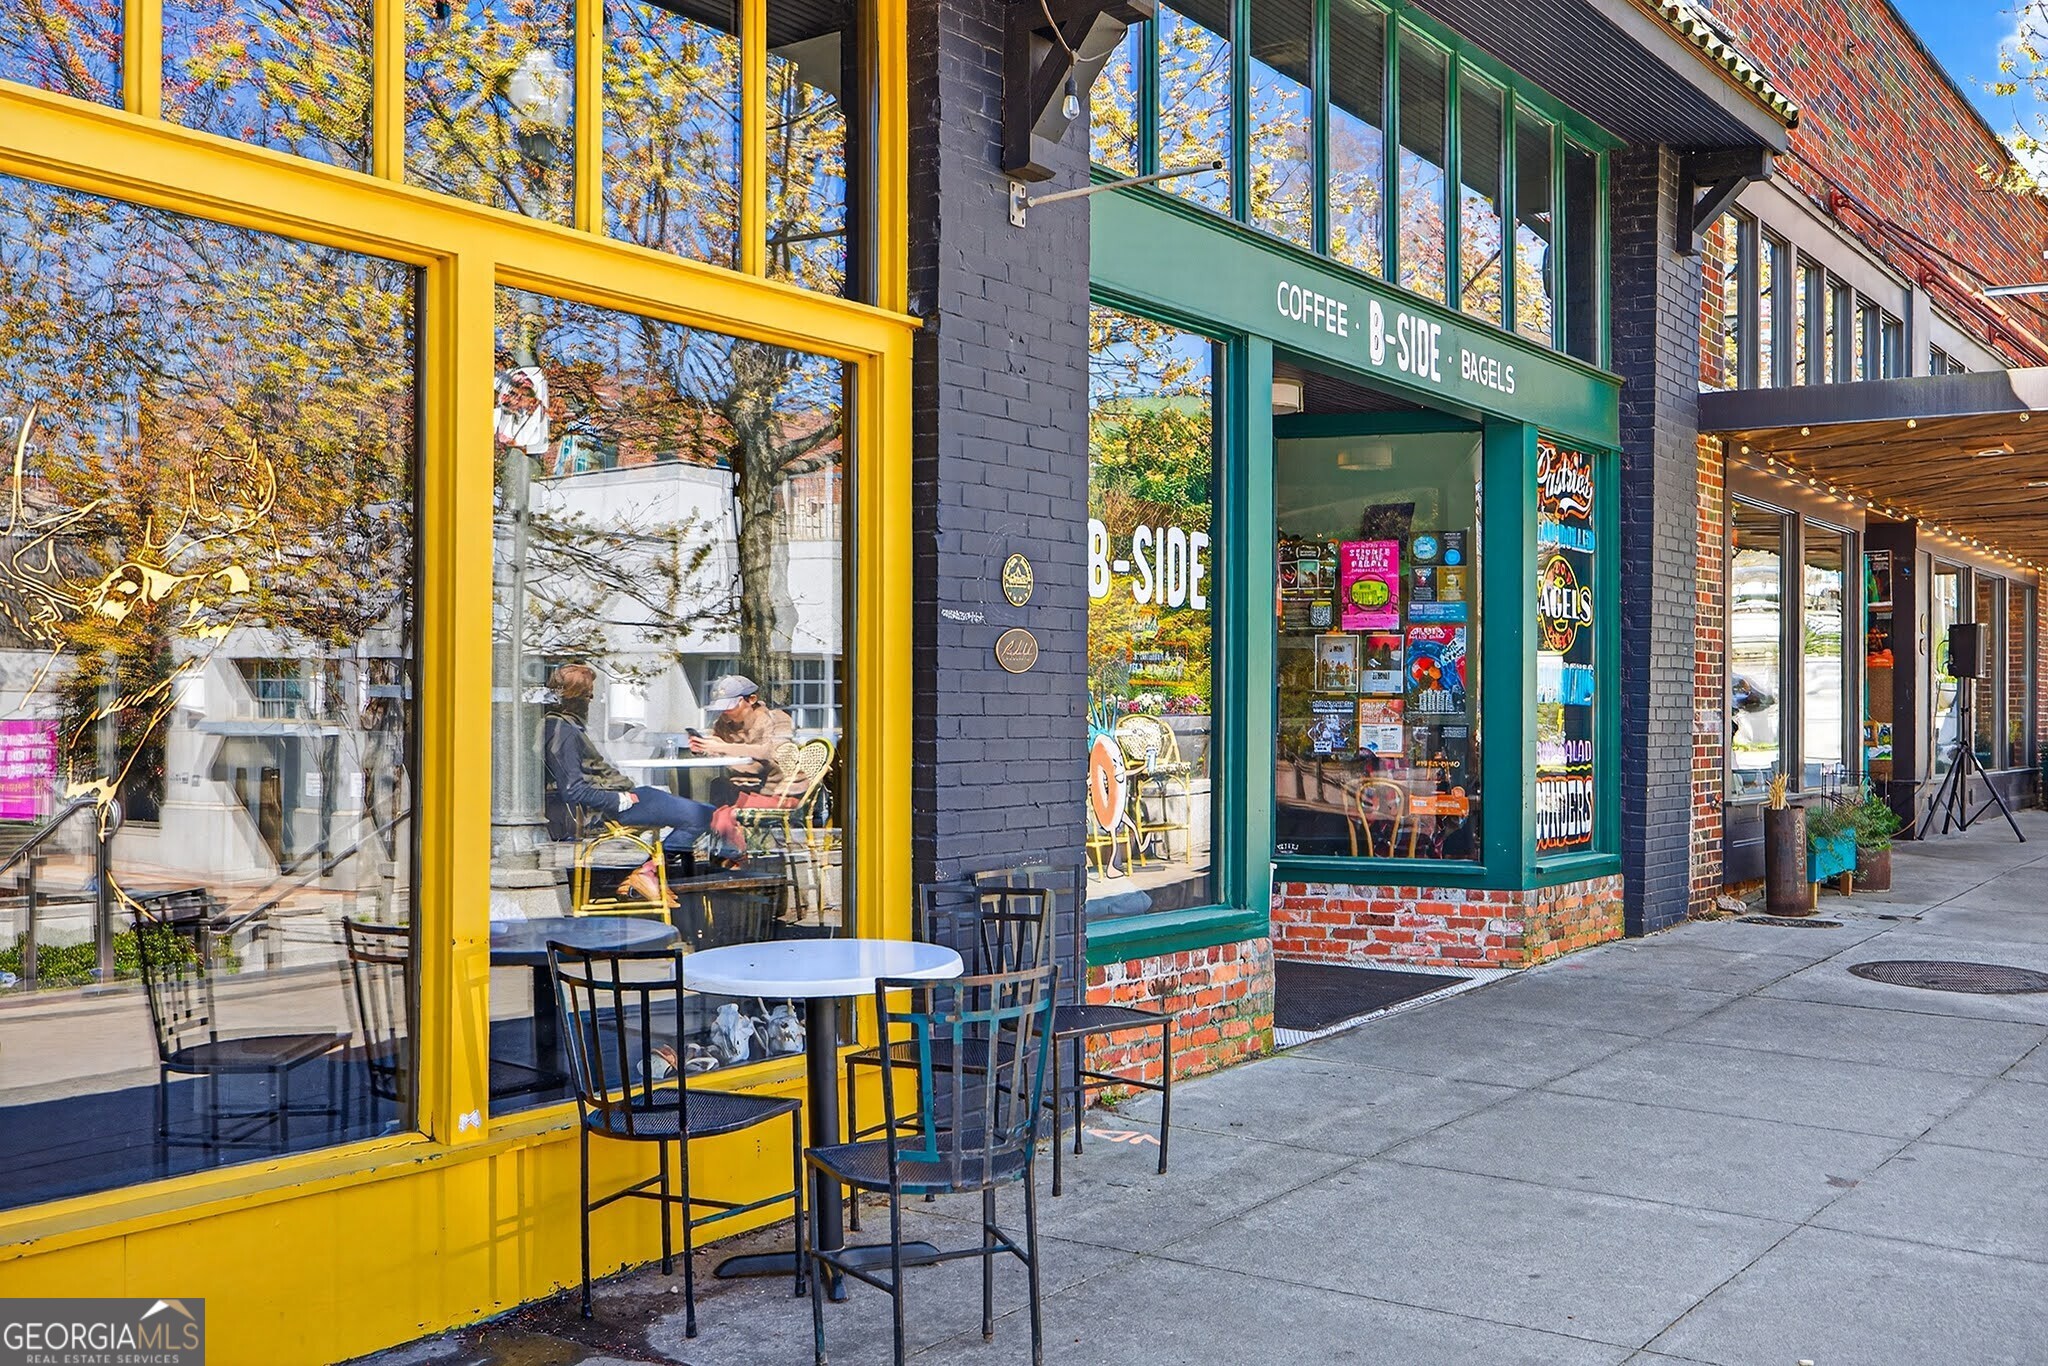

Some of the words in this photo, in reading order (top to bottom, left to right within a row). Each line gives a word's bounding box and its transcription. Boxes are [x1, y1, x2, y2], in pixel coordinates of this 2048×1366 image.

[1277, 281, 1348, 337] COFFEE
[1369, 300, 1442, 383] B-SIDE
[1461, 349, 1516, 395] BAGELS
[1087, 518, 1209, 610] B-SIDE
[1537, 585, 1592, 623] AGELS
